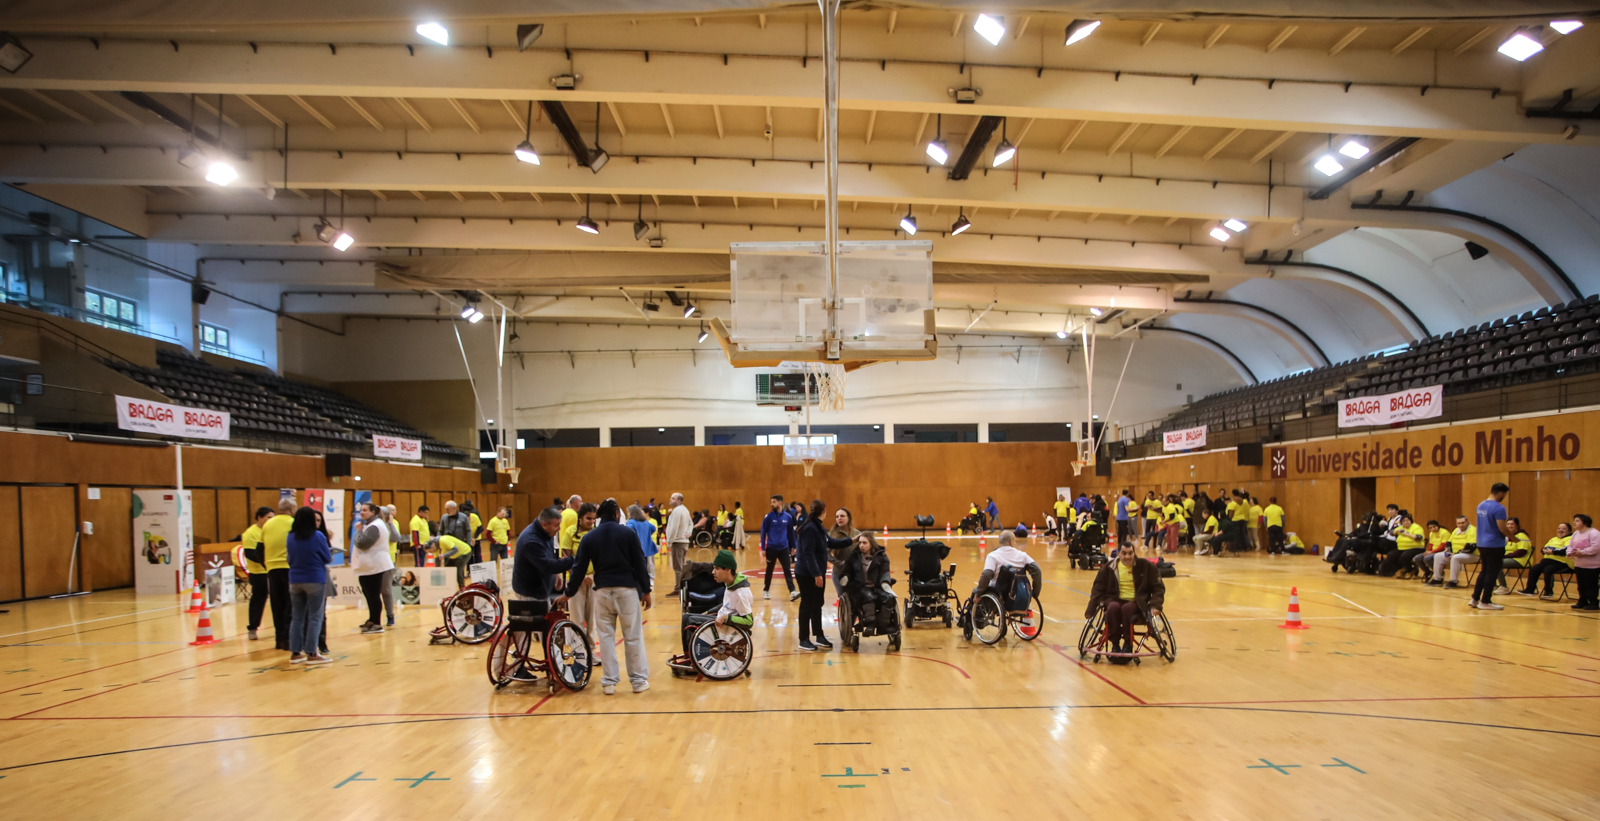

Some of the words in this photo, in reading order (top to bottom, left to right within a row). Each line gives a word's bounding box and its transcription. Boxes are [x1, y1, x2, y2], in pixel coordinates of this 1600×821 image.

[128, 402, 174, 423] BRAGA
[184, 411, 223, 429] BRAGA
[1346, 400, 1380, 416] BRAGA
[1390, 393, 1432, 412] BRAGA
[1295, 439, 1422, 474] Universidade
[1431, 435, 1464, 467] do
[1475, 425, 1581, 465] Minho
[342, 585, 363, 595] BRA
